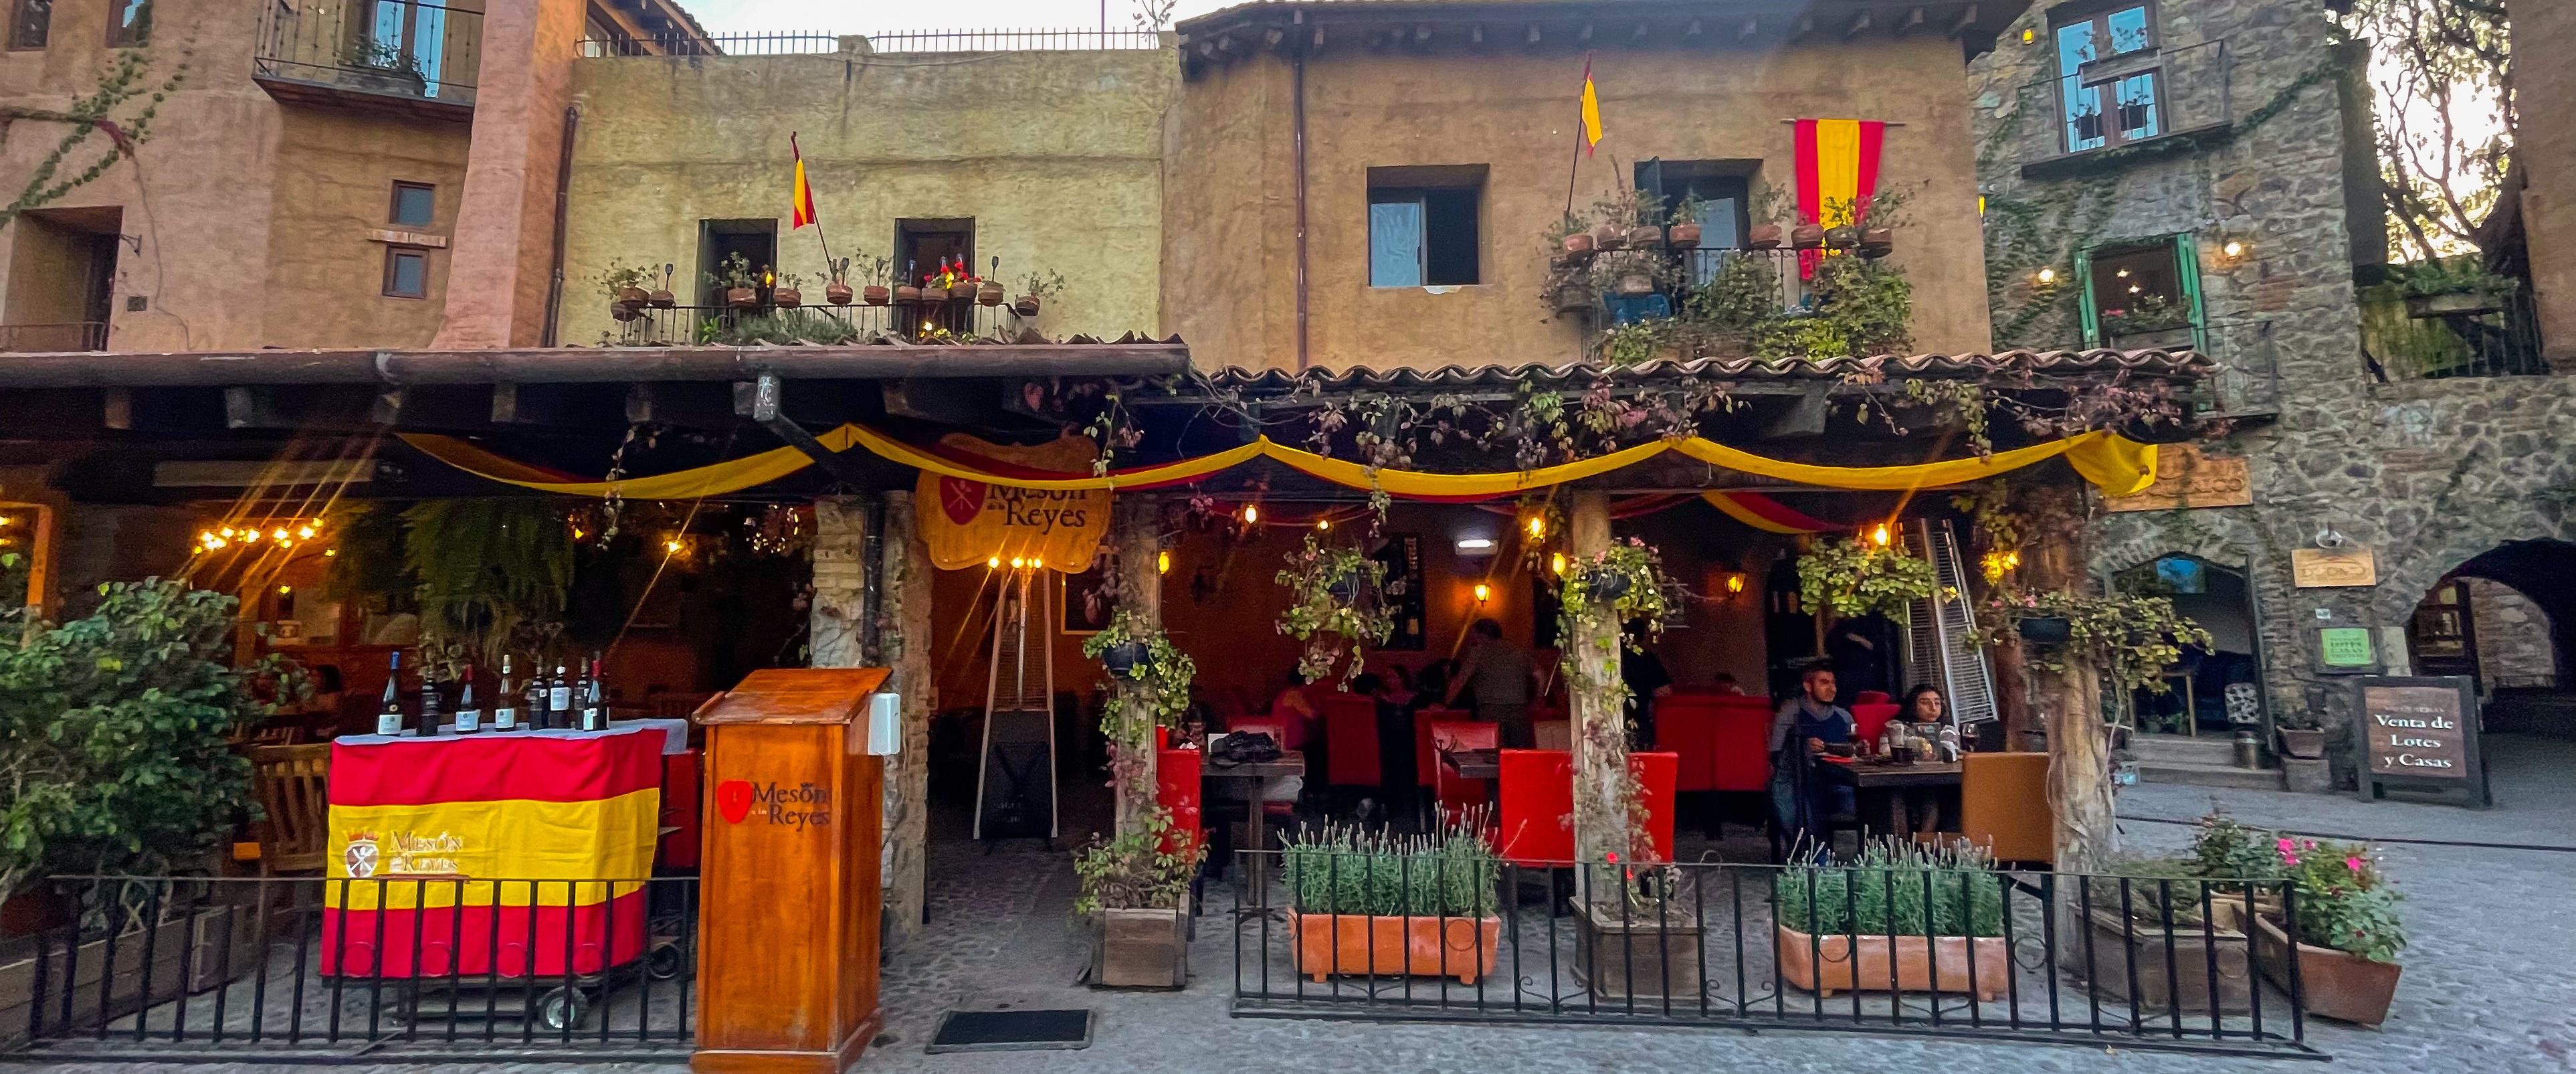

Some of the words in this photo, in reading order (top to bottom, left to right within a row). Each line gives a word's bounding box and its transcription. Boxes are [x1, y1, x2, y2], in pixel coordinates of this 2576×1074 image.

[1003, 499, 1086, 535] Reyes
[2375, 715, 2427, 728] Venta
[2431, 716, 2454, 729] de
[2391, 734, 2442, 747] Lotes
[2384, 756, 2395, 768] y
[2399, 753, 2452, 768] Casas
[769, 804, 830, 832] Reyes
